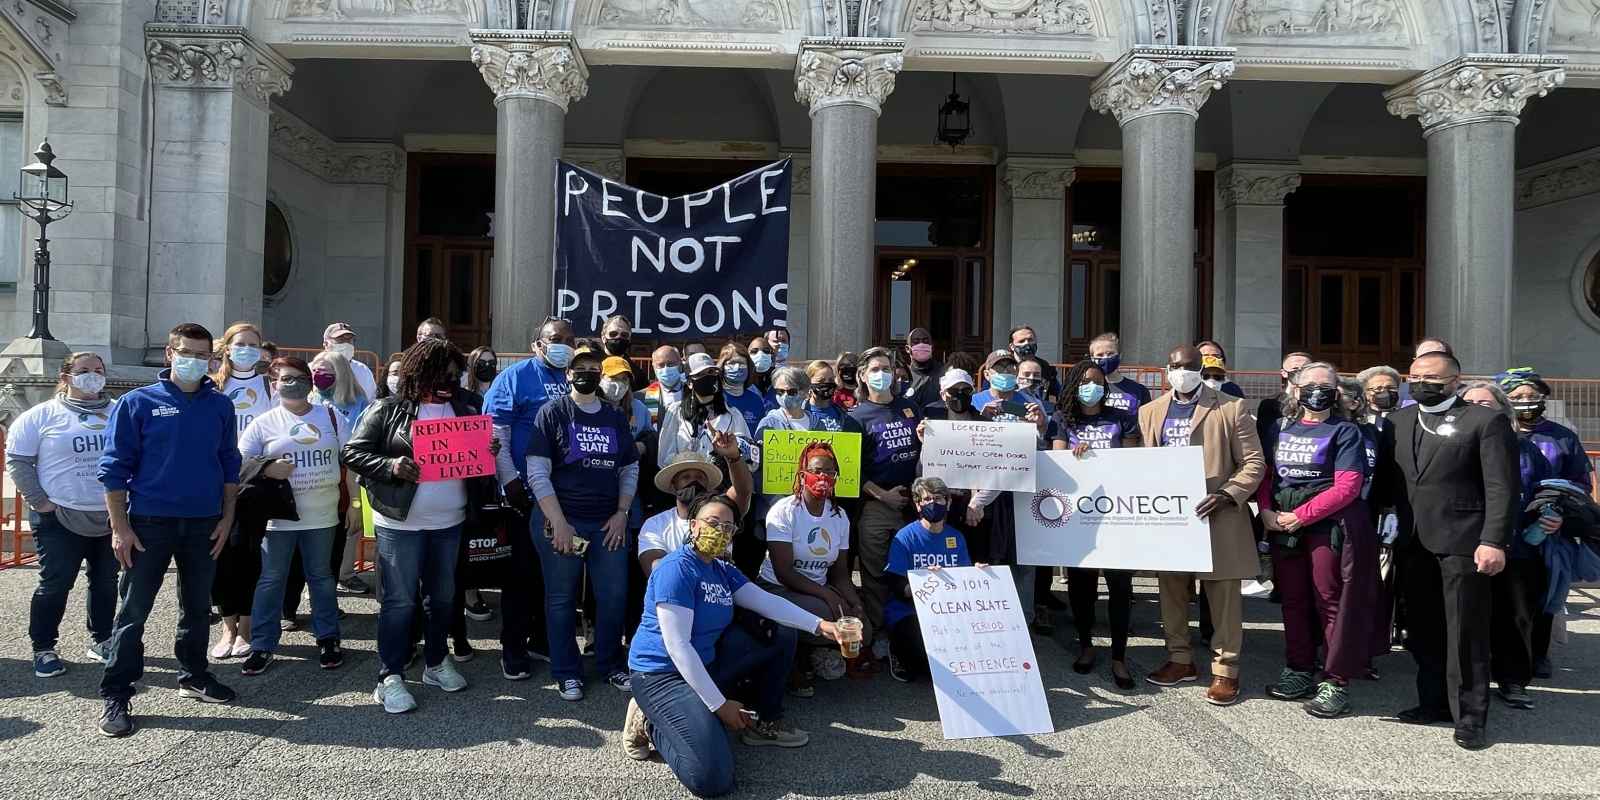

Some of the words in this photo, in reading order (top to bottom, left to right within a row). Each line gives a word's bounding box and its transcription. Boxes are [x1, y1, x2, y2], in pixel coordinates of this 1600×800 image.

[564, 169, 788, 228] PEOPLE
[631, 236, 741, 273] NOT
[557, 283, 788, 334] PRISONS
[415, 420, 489, 437] REINVEST
[886, 421, 903, 430] PASS
[951, 422, 987, 432] LOCKED
[576, 433, 610, 444] CLEAN
[768, 433, 779, 445] A
[789, 432, 834, 445] Record
[882, 427, 912, 440] CLEAN
[1076, 431, 1113, 441] CLEAN
[1289, 436, 1313, 444] PASS
[431, 438, 449, 451] IN
[580, 442, 609, 453] SLATE
[886, 436, 912, 449] SLATE
[1279, 441, 1318, 453] CLEAN
[767, 448, 799, 461] Shoul
[940, 448, 977, 457] UNLOCK
[1277, 450, 1312, 463] SLATE
[440, 463, 484, 479] LIVES
[767, 466, 794, 483] Lifet
[1288, 468, 1322, 478] CONECT
[1077, 495, 1189, 514] CONECT
[469, 538, 498, 549] STOP
[912, 553, 958, 567] PEOPLE
[914, 576, 940, 604] PASS
[963, 579, 990, 591] 1019
[930, 600, 973, 615] CLEAN
[975, 599, 1011, 612] SLATE
[971, 621, 1005, 633] PERIOD
